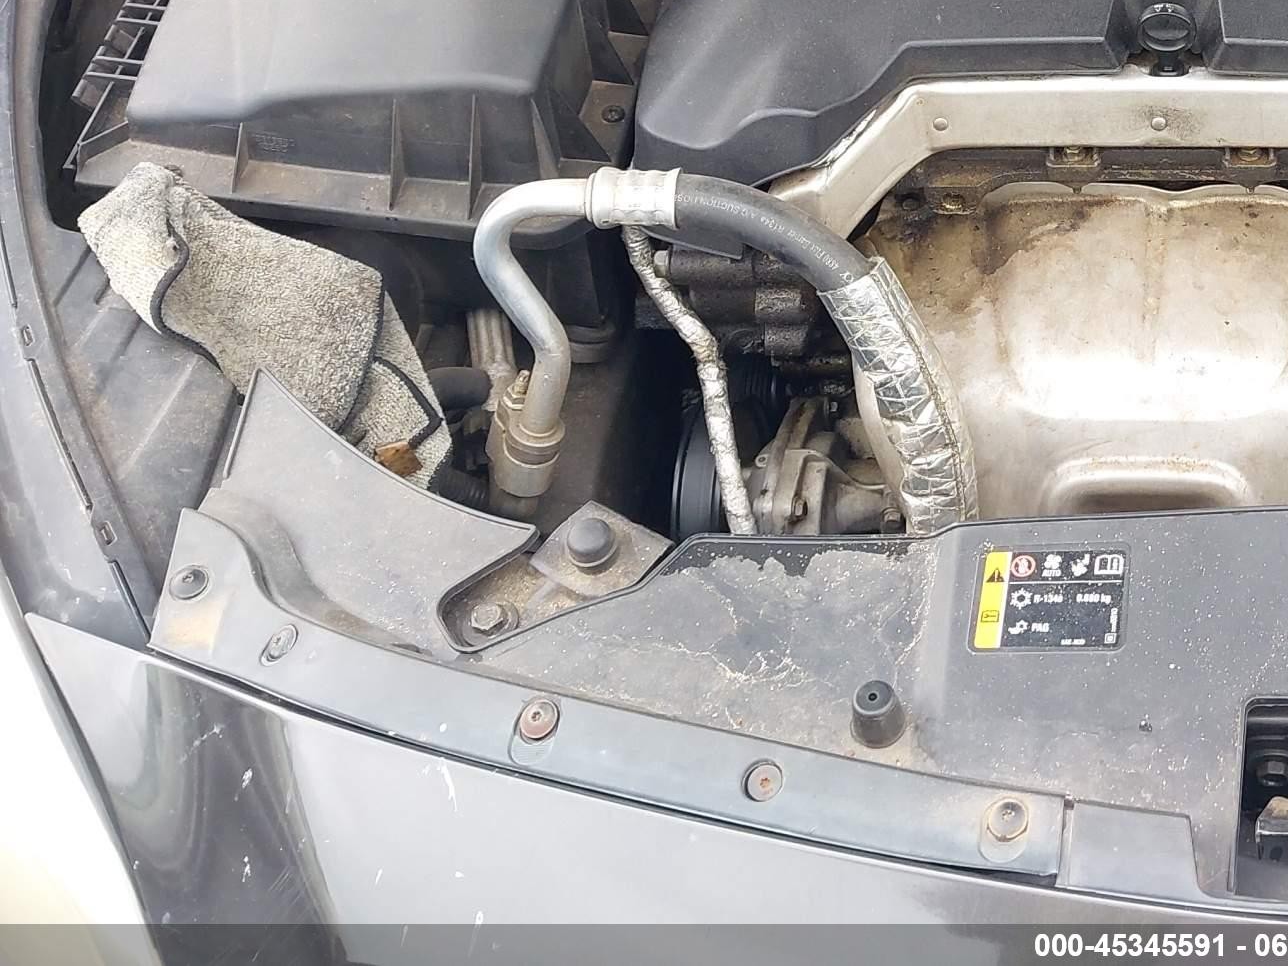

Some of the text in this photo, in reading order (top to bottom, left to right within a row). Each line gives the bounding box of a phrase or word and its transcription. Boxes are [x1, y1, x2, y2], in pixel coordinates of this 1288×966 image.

[698, 196, 741, 215] SUCTION
[1041, 569, 1062, 577] AUTO
[1031, 622, 1050, 633] PAG
